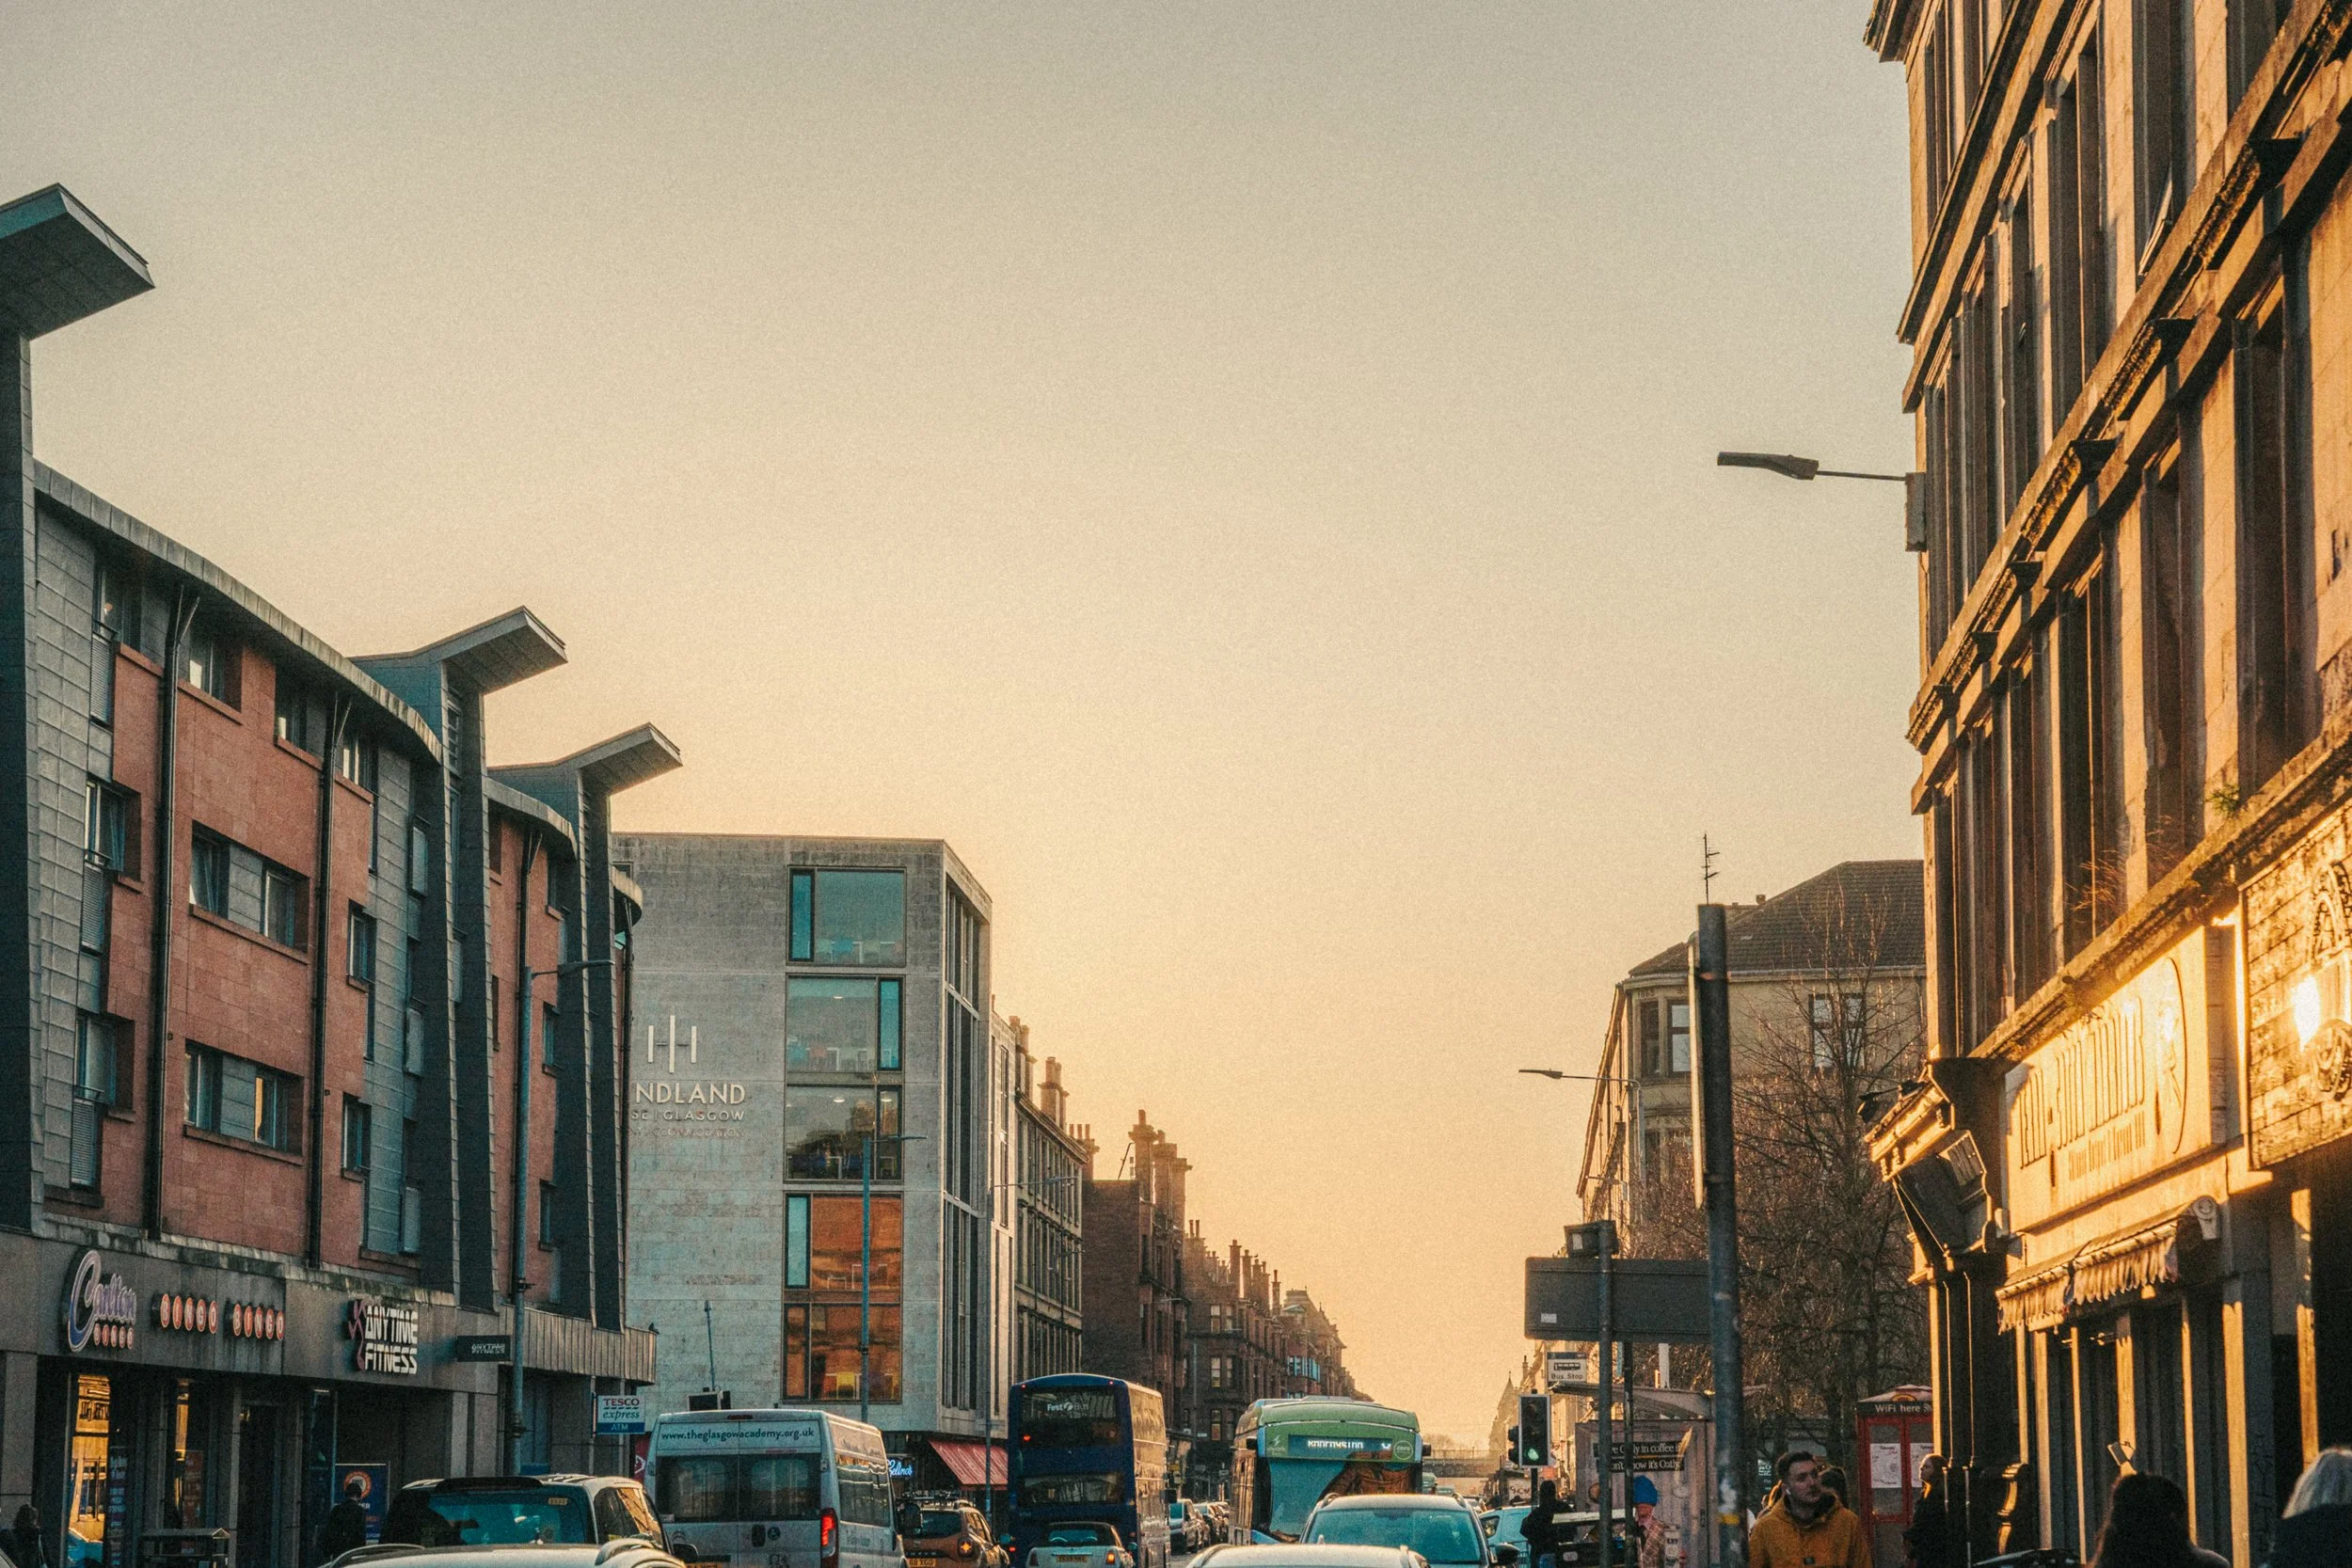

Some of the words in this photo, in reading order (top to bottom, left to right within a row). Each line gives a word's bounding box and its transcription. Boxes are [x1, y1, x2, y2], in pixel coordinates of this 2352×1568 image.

[635, 1083, 745, 1104] NDLAND
[662, 1110, 744, 1121] GLASGOW
[161, 1294, 218, 1332] BINGO
[233, 1305, 285, 1339] BINGO
[365, 1306, 419, 1344] ANYTIME
[95, 1323, 135, 1349] BINGO
[365, 1342, 418, 1374] FITNESS
[603, 1398, 640, 1406] TESCO
[1046, 1402, 1063, 1412] First
[1875, 1403, 1897, 1413] WiFi
[1900, 1403, 1921, 1413] here
[602, 1410, 640, 1420] express
[661, 1426, 815, 1442] www.theglasgowacademy.org.uk
[1619, 1444, 1640, 1455] Oly
[1642, 1444, 1649, 1453] in
[1650, 1443, 1675, 1453] coffee
[1633, 1462, 1647, 1470] ow
[1648, 1460, 1659, 1469] it's
